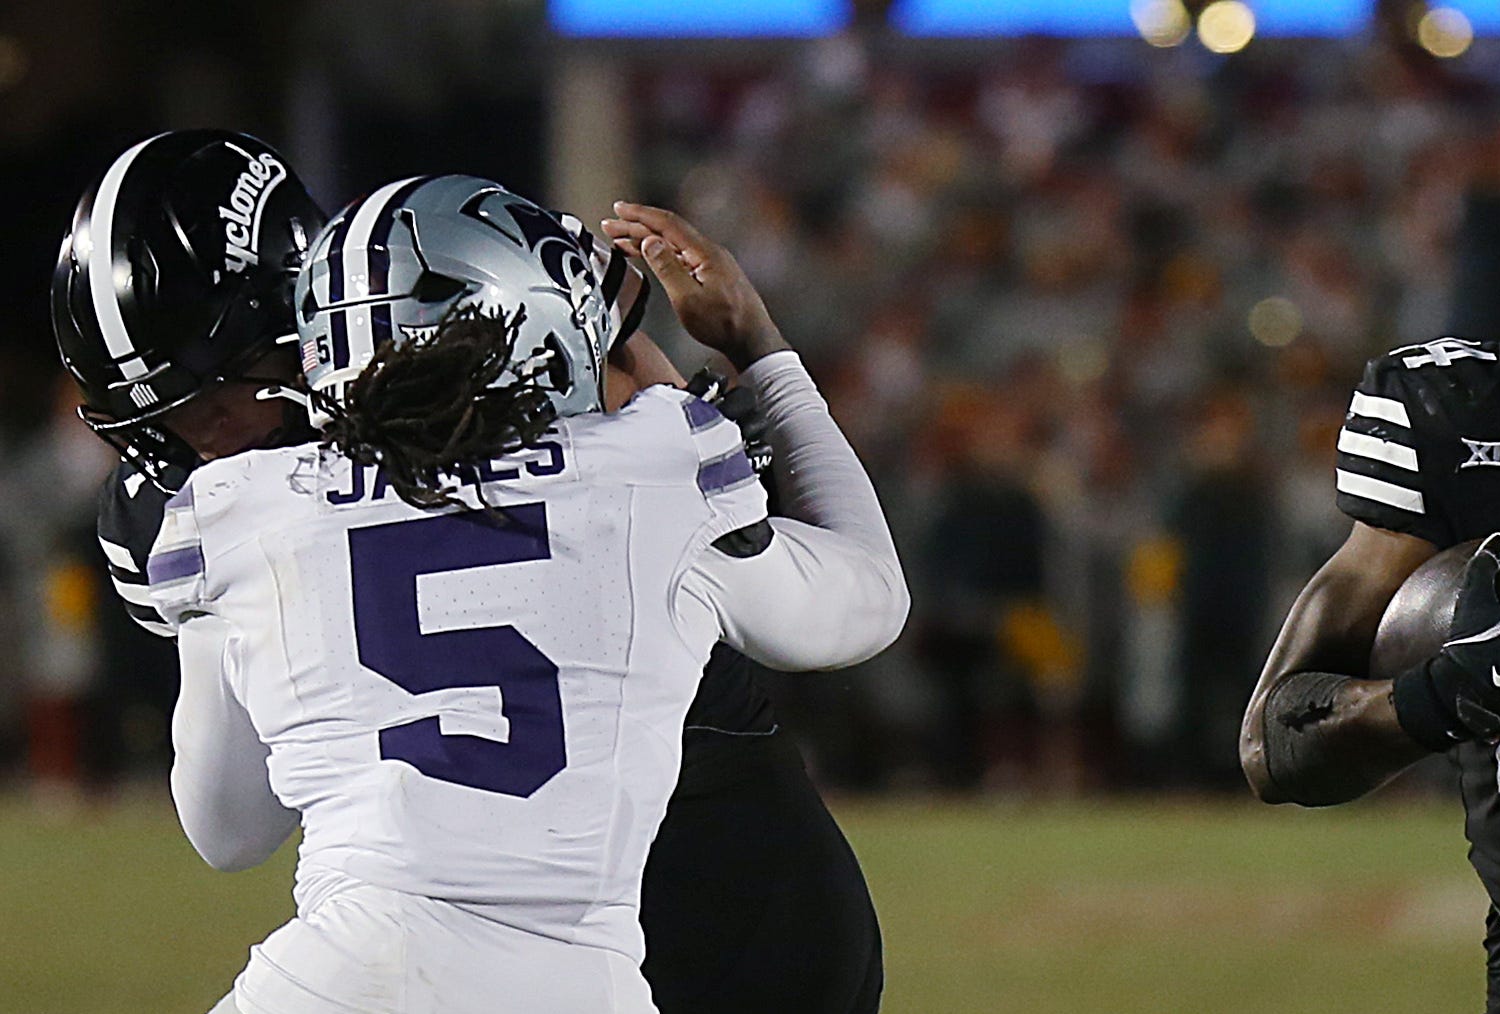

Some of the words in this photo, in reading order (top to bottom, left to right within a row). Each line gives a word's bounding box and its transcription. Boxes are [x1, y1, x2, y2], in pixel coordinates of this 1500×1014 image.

[213, 152, 287, 284] yclones
[314, 334, 331, 364] 5
[347, 501, 568, 800] 5
